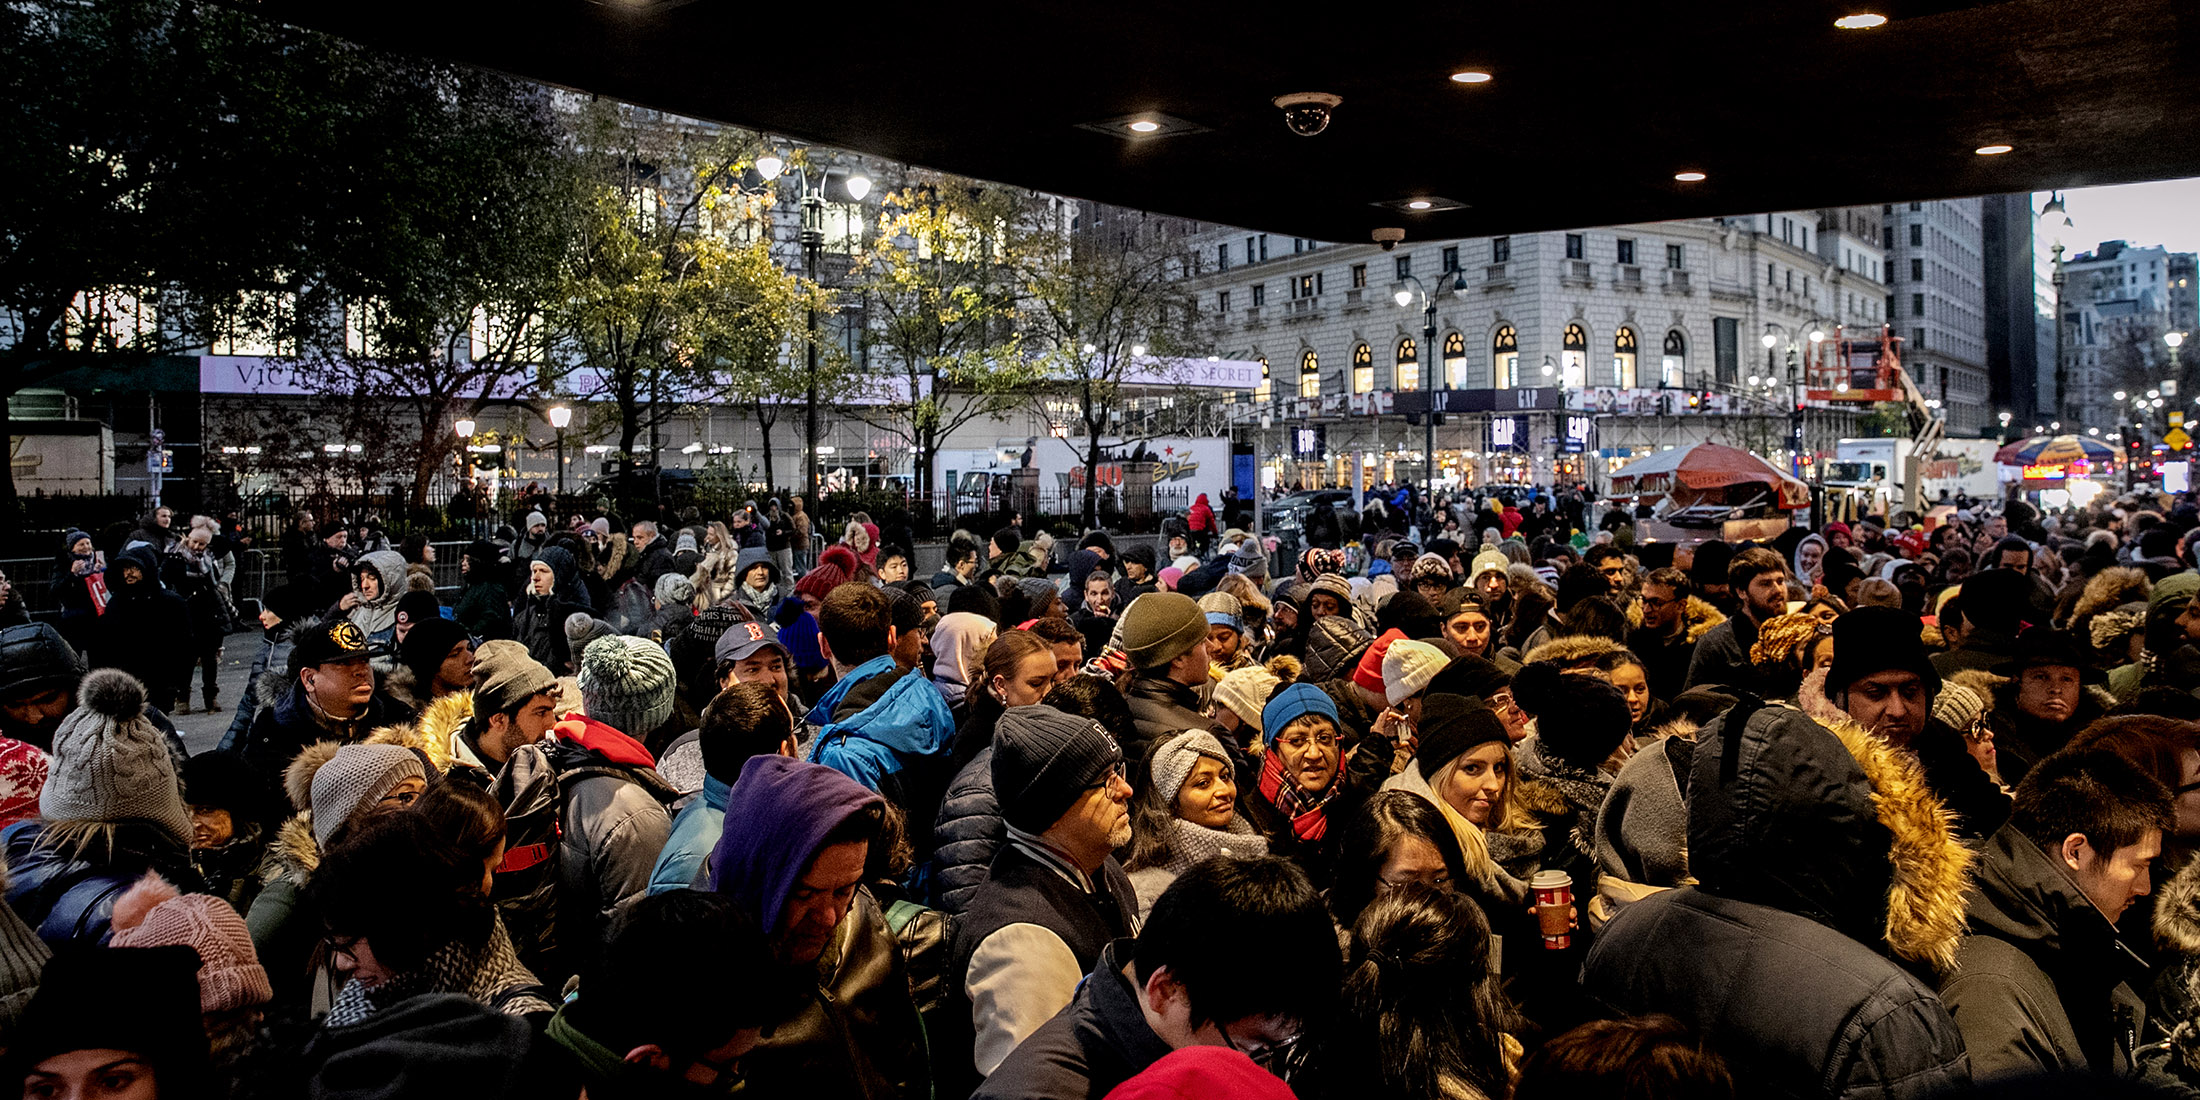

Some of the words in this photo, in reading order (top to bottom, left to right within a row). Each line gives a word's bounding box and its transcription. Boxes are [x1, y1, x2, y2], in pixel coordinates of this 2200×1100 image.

[1200, 365, 1254, 382] SECRET
[1434, 391, 1449, 411] AP
[1517, 389, 1538, 408] GAP
[1492, 418, 1515, 446] GAP
[1567, 416, 1589, 444] GAP
[743, 622, 765, 641] B
